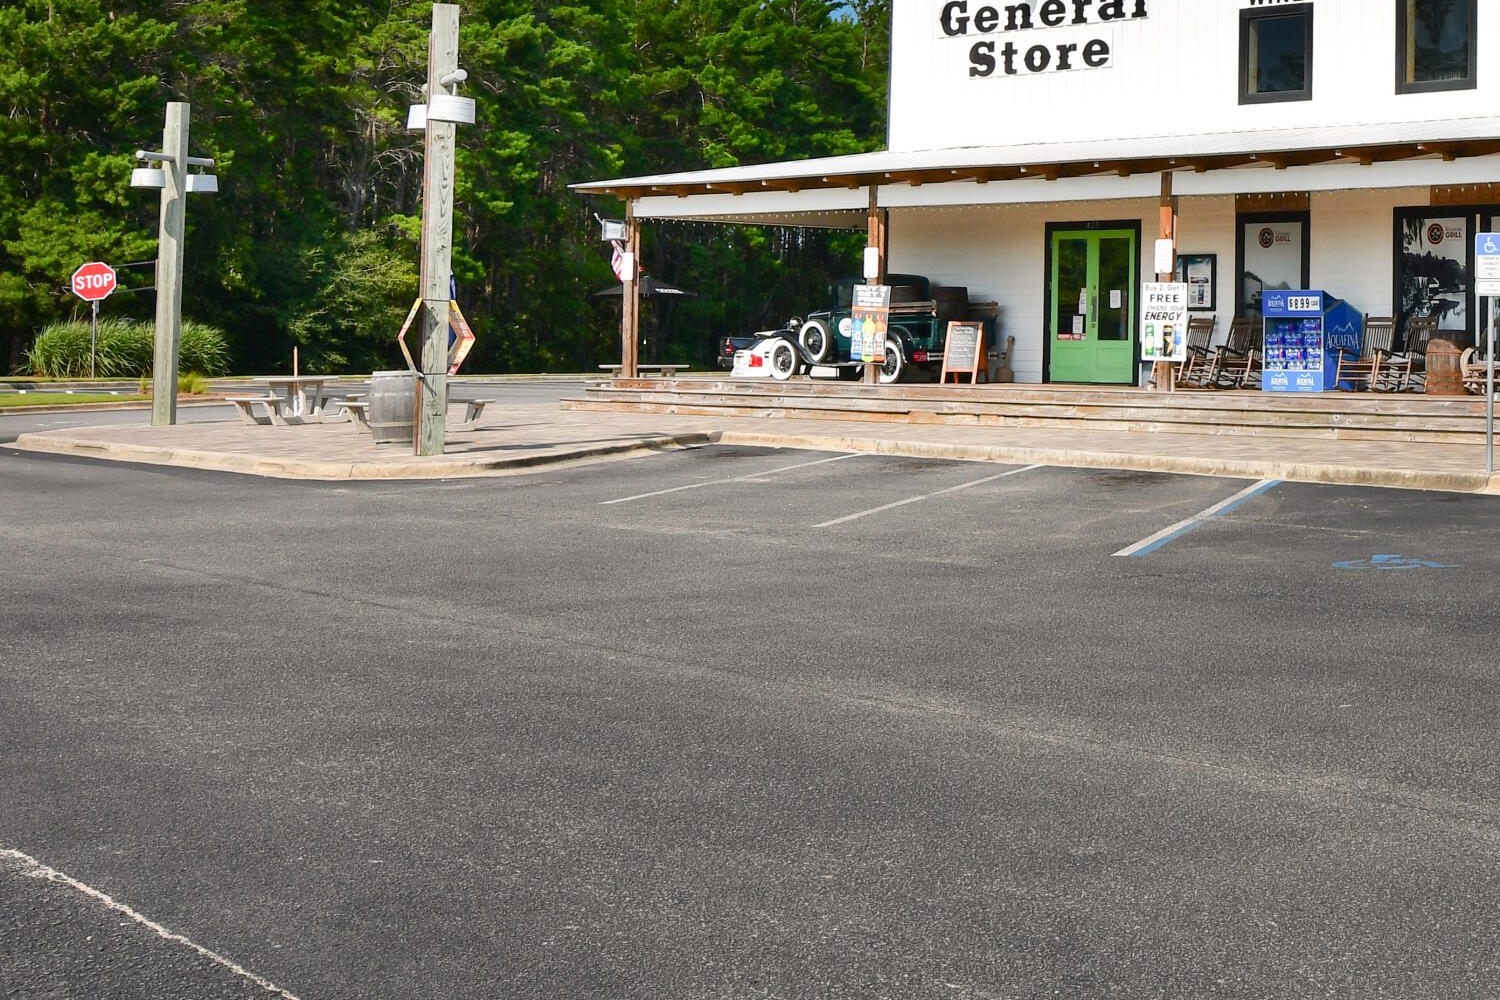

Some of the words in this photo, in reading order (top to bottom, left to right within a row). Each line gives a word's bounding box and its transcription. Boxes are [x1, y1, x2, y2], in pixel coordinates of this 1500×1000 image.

[969, 38, 1110, 77] Store
[76, 273, 113, 290] STOP
[1150, 294, 1179, 302] FREE
[1144, 311, 1182, 321] ENERGY
[1325, 331, 1360, 350] AQUAFINA
